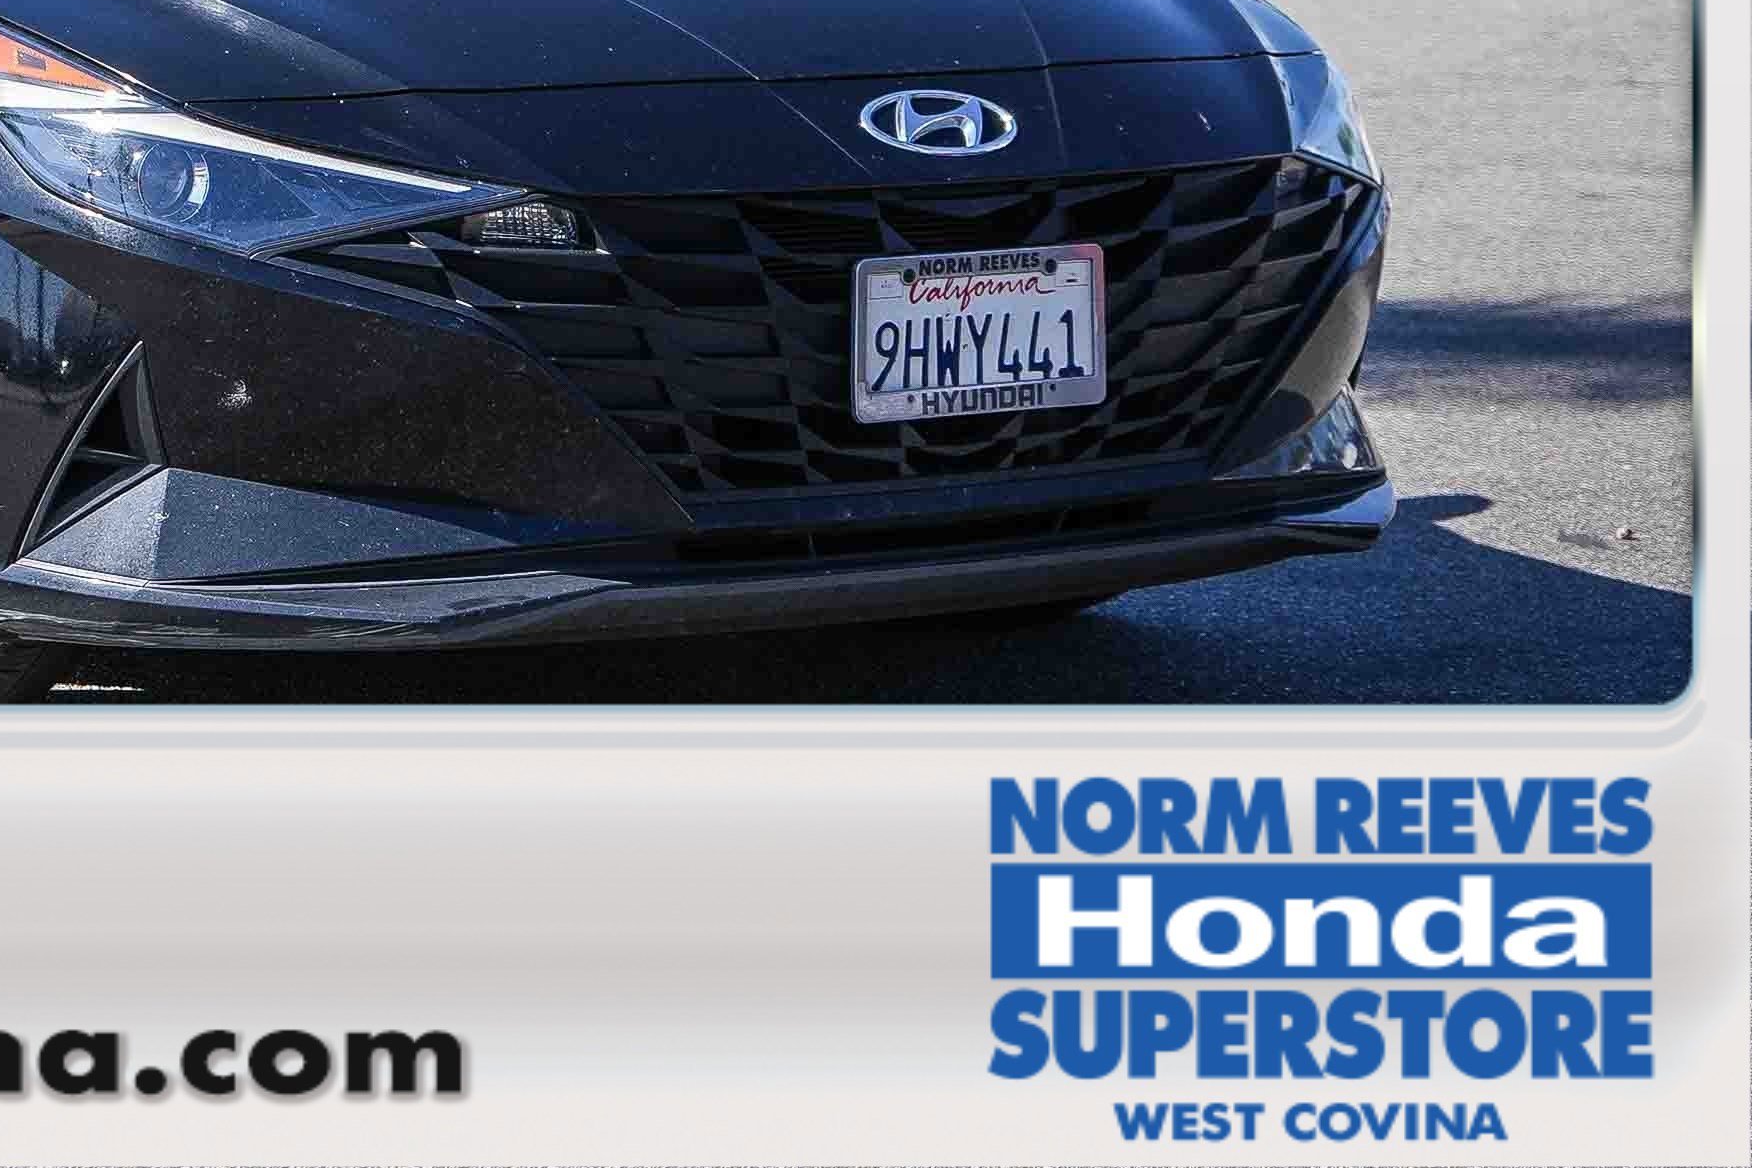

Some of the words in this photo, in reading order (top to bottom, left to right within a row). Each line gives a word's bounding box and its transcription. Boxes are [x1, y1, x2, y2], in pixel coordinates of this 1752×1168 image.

[919, 257, 973, 276] NORM
[979, 252, 1041, 272] REEVES
[909, 275, 1056, 311] California
[871, 309, 1085, 392] 9HWY441
[921, 383, 1044, 416] HYUNDAI
